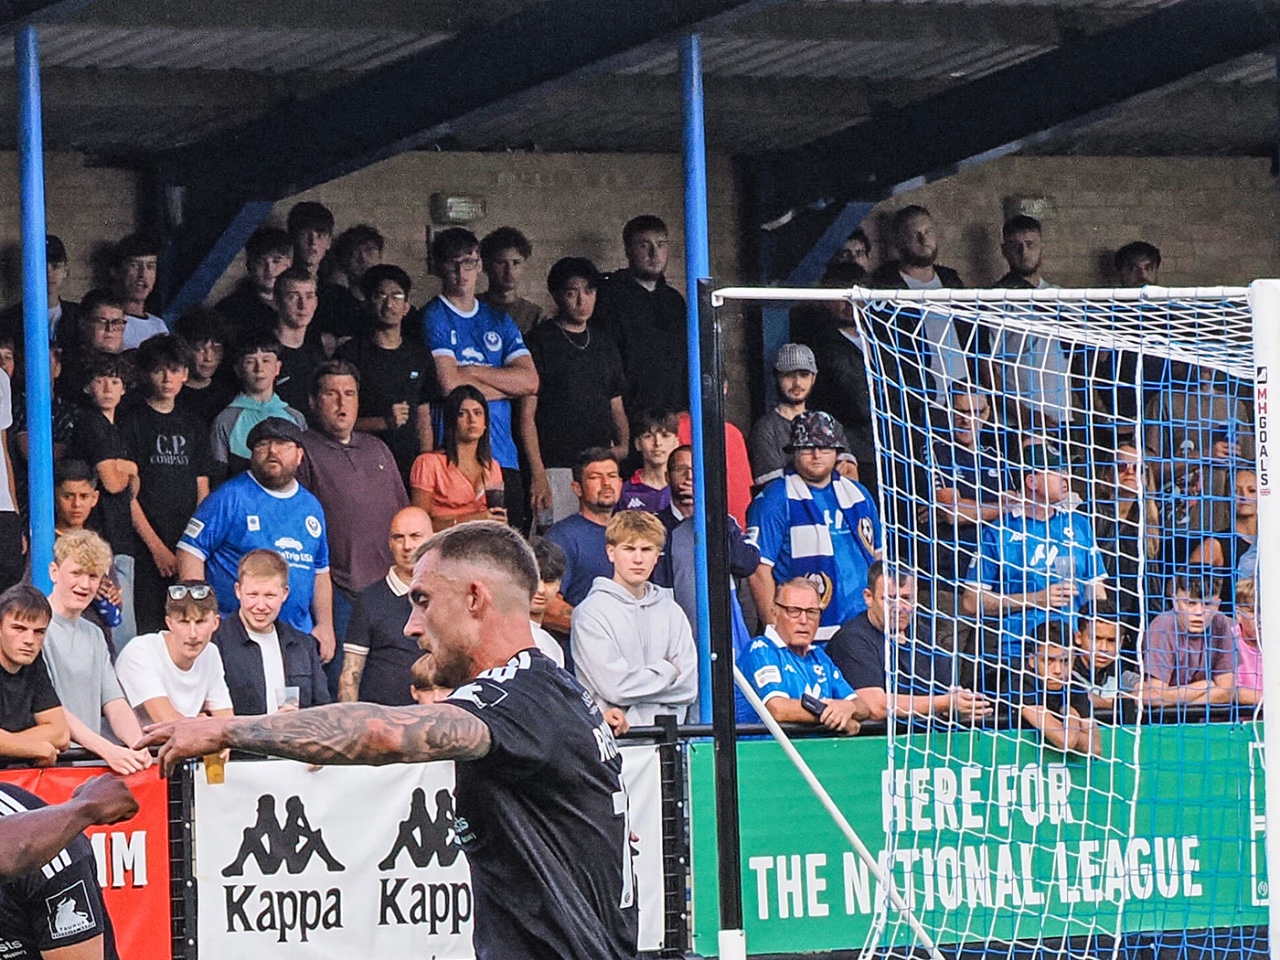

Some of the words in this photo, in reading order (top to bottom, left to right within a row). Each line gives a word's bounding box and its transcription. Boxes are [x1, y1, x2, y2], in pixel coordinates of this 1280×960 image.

[881, 766, 984, 833] HERE
[997, 762, 1074, 828] FOR
[377, 877, 472, 935] Kapp
[749, 852, 830, 920] THE
[844, 842, 1045, 915] NATIONAL
[1057, 835, 1203, 904] LEAGUE
[222, 884, 344, 943] Kappa
